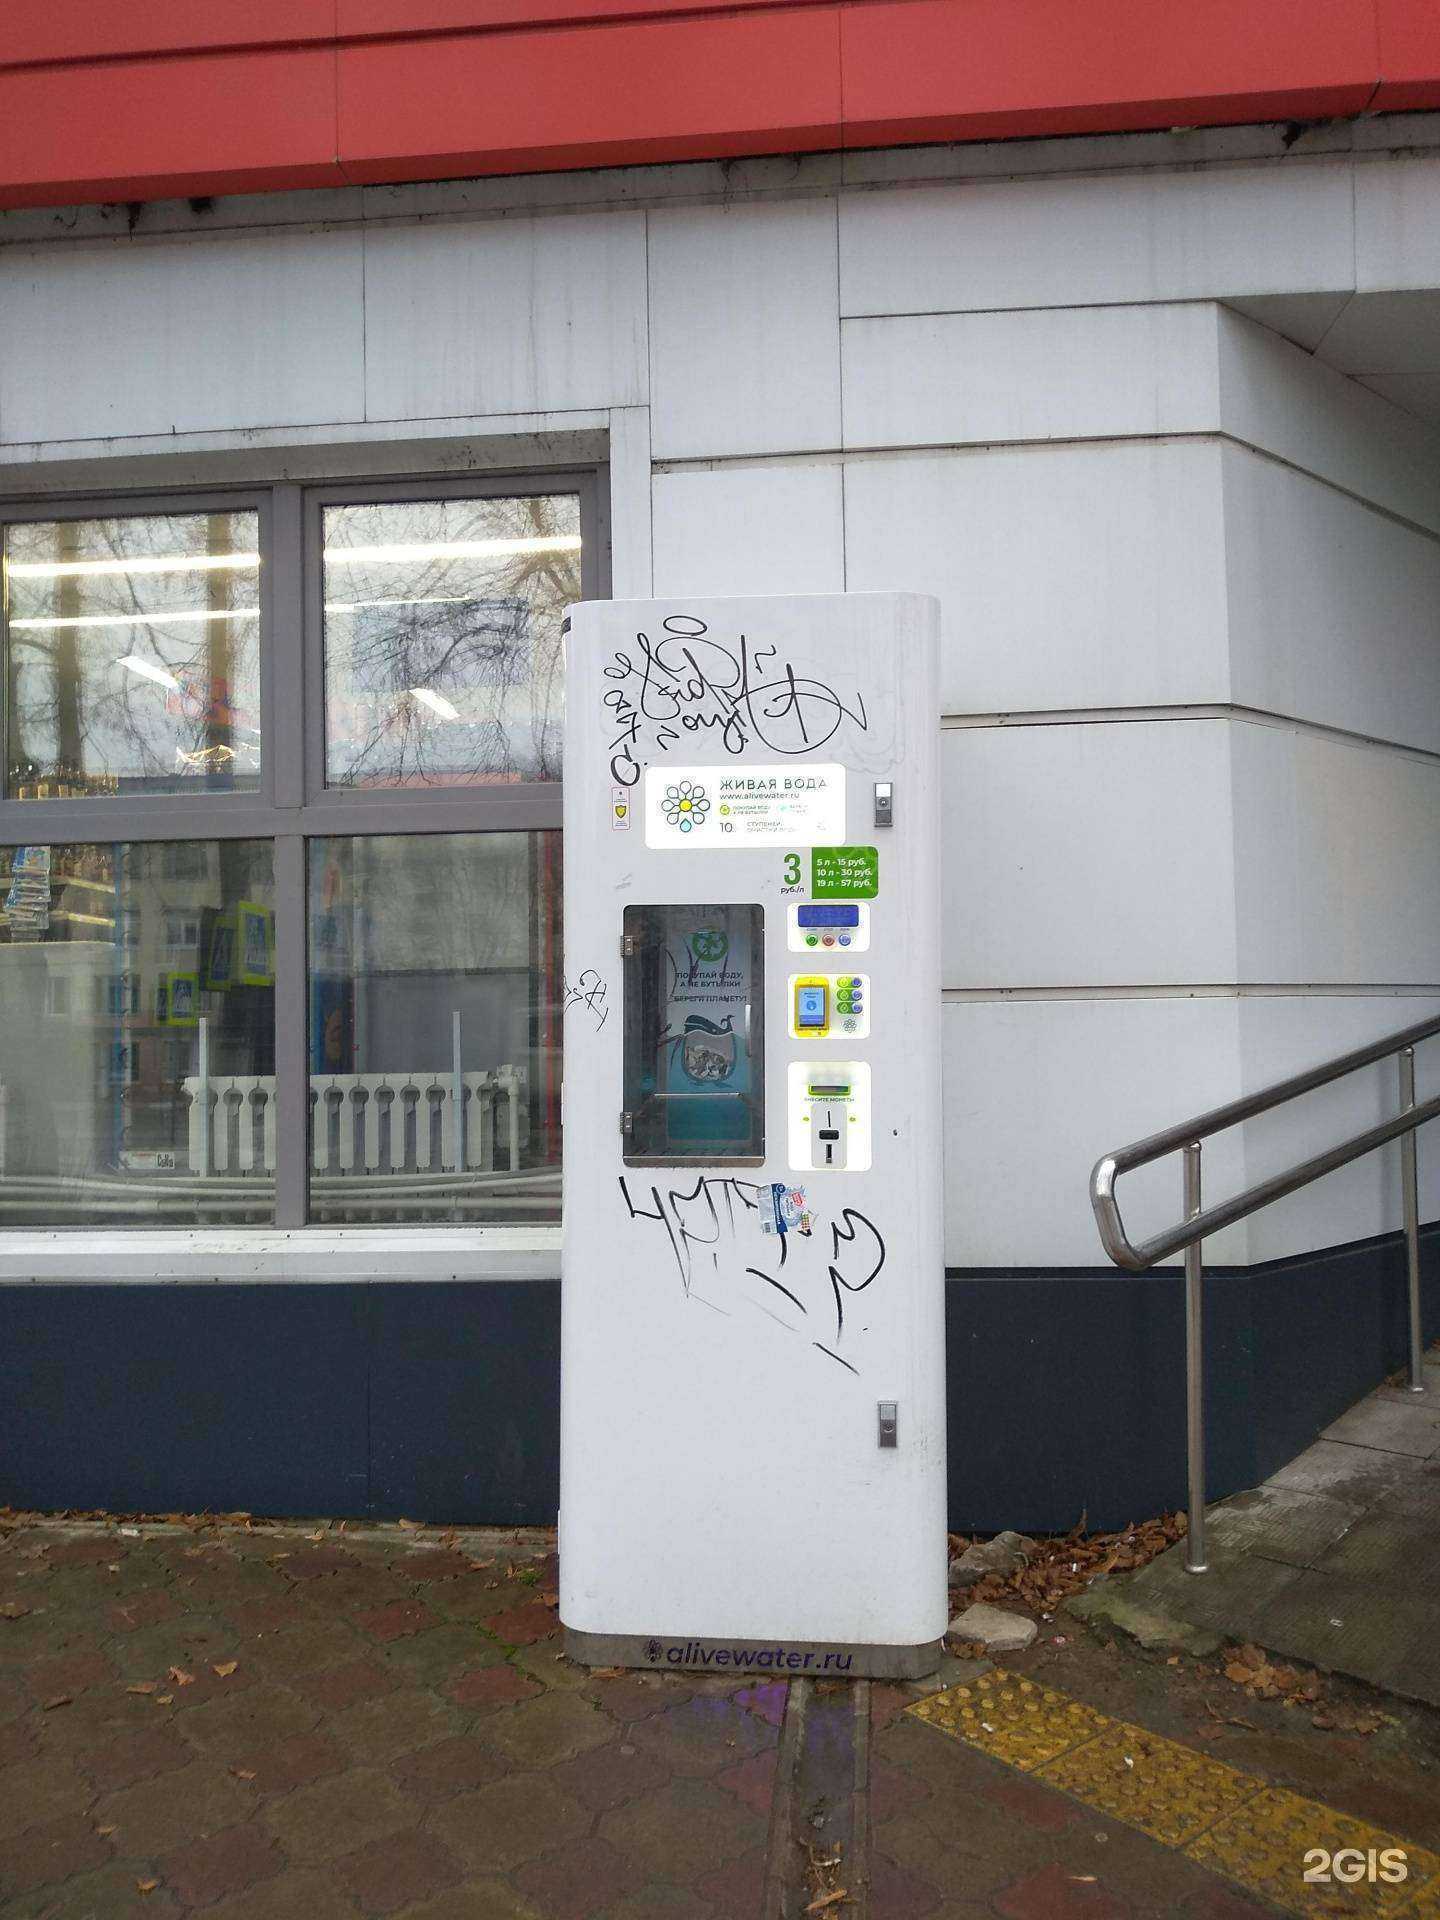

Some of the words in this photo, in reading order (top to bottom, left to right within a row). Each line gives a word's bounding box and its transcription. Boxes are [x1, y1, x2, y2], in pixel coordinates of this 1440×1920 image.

[720, 779, 777, 790] ЖИВАЯ
[784, 778, 827, 789] ВОДА
[719, 792, 800, 800] www.alivewater.ru
[720, 822, 733, 833] 10
[848, 858, 867, 867] руб.
[784, 853, 801, 885] 3
[817, 869, 826, 877] 10
[854, 868, 873, 877] руб.
[853, 878, 872, 888] руб.
[781, 886, 805, 894] руб./л
[667, 1642, 853, 1670] alivewater.ru
